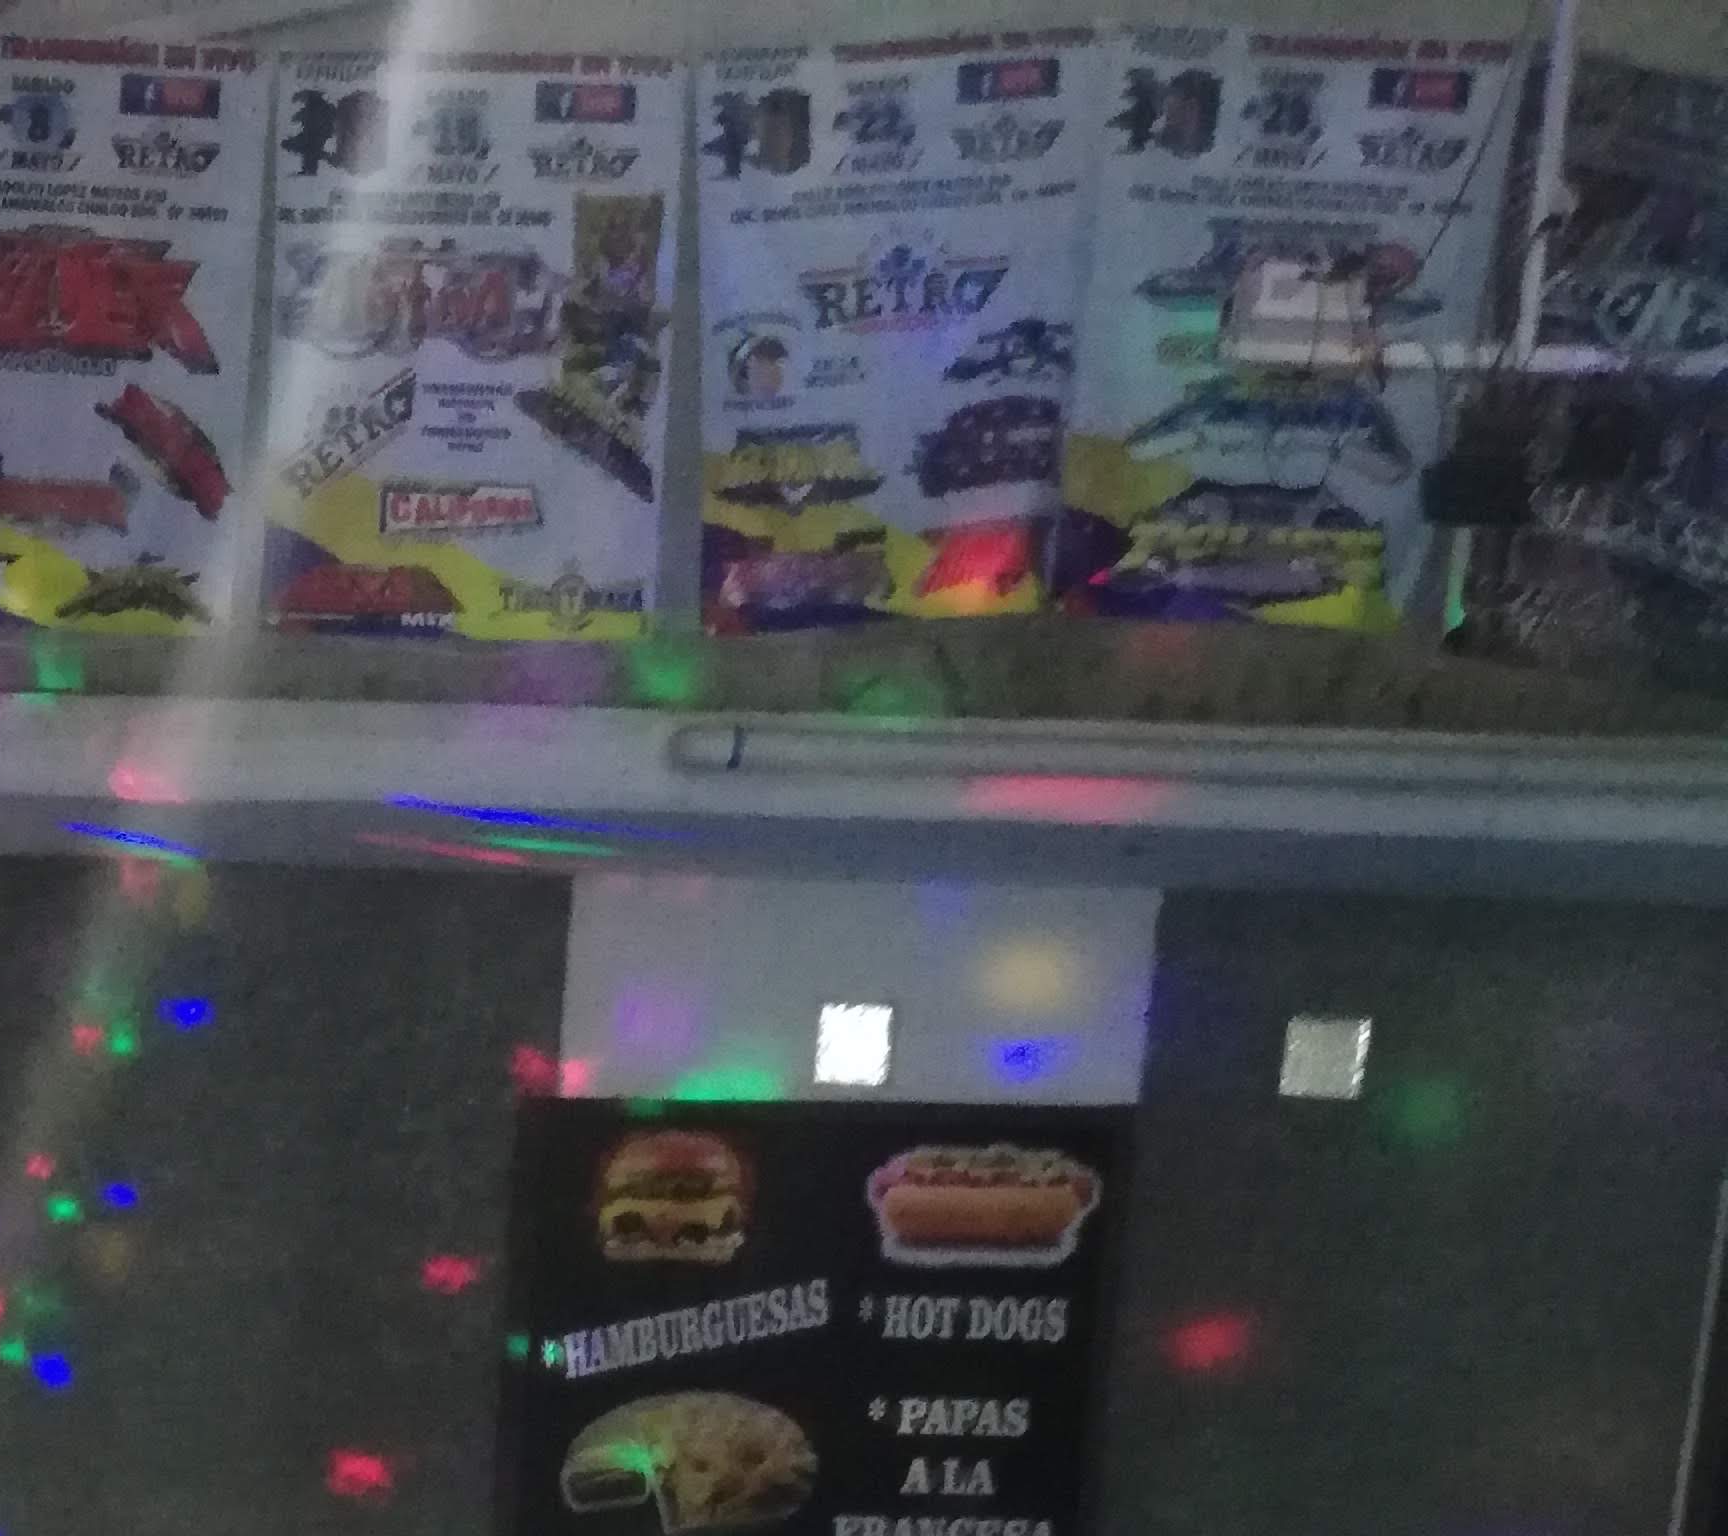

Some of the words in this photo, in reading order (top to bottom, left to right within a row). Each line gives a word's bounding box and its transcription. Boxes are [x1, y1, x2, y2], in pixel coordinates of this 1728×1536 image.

[563, 1279, 829, 1379] HAMBURGUESAS
[881, 1296, 958, 1340] HOT
[966, 1297, 1068, 1343] DOGS
[897, 1398, 1030, 1437] PAPAS
[899, 1456, 928, 1495] A
[941, 1457, 996, 1496] LA
